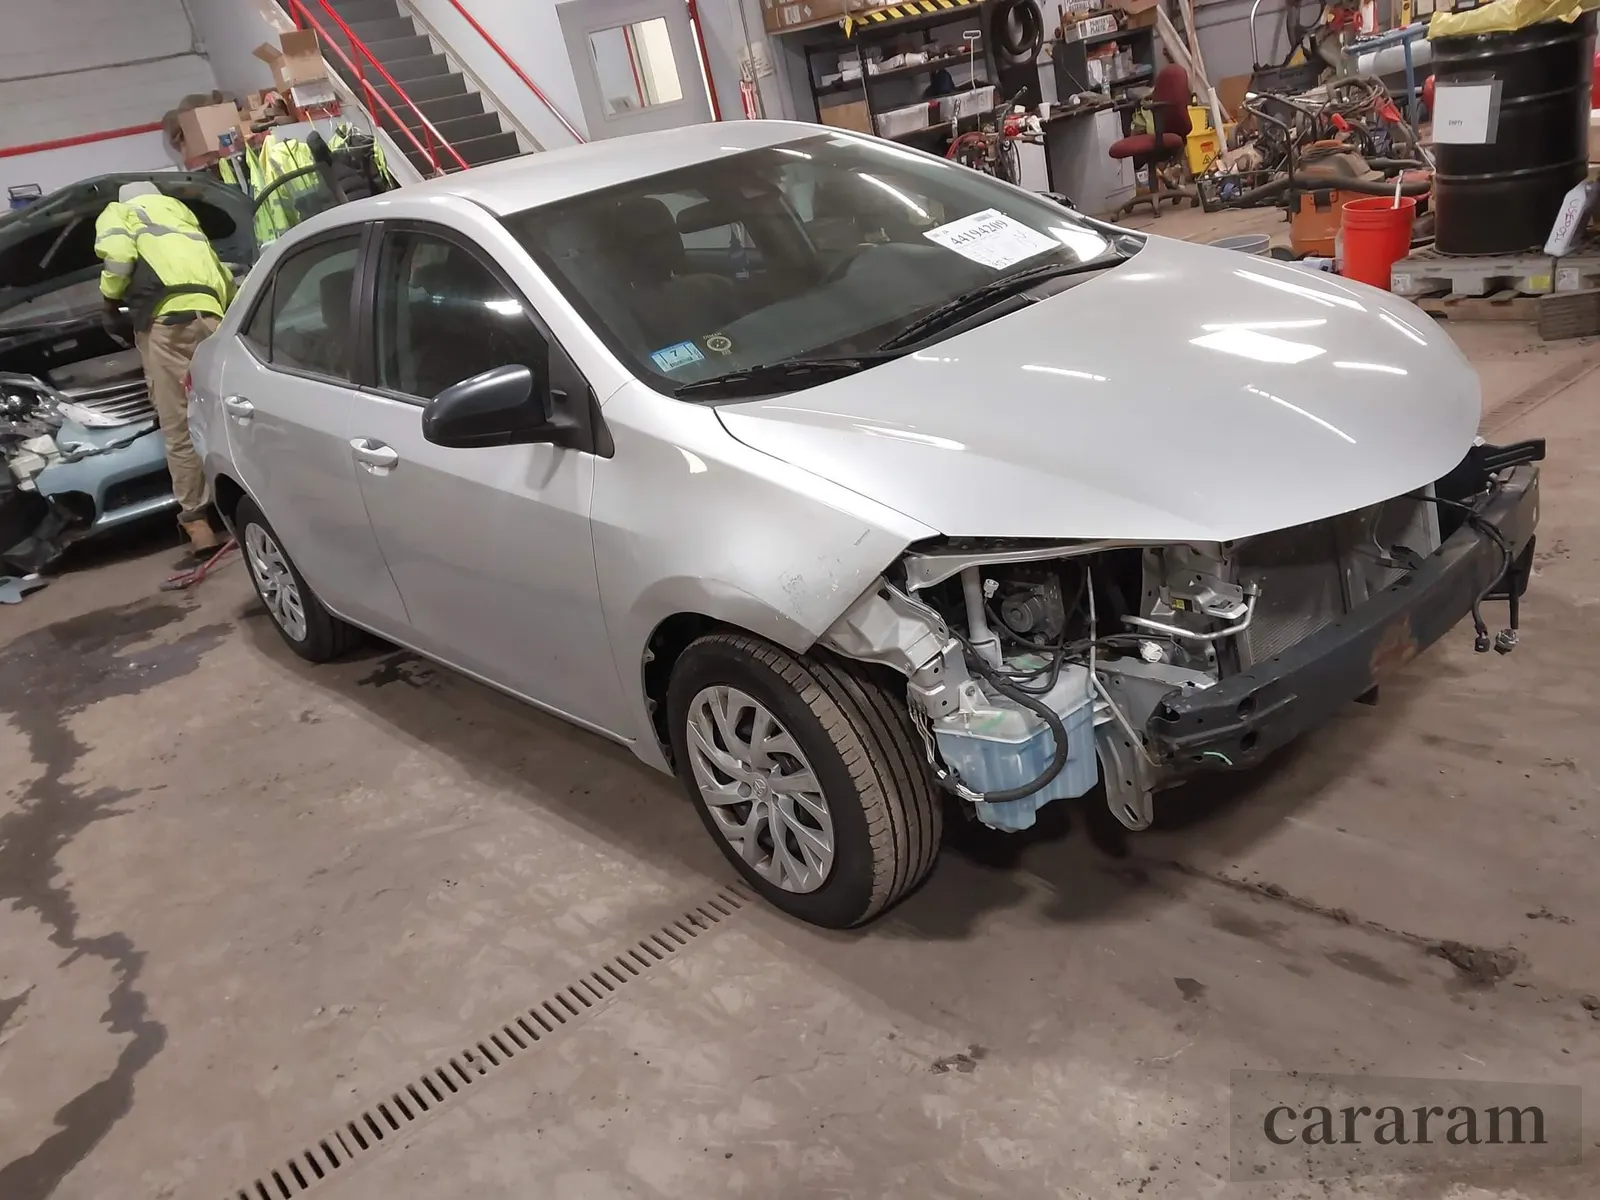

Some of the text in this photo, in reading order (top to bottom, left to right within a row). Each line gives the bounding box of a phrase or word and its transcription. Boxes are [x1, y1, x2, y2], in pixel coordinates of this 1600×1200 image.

[1564, 198, 1580, 228] USED
[950, 219, 1008, 246] 44194209
[670, 349, 678, 357] 7
